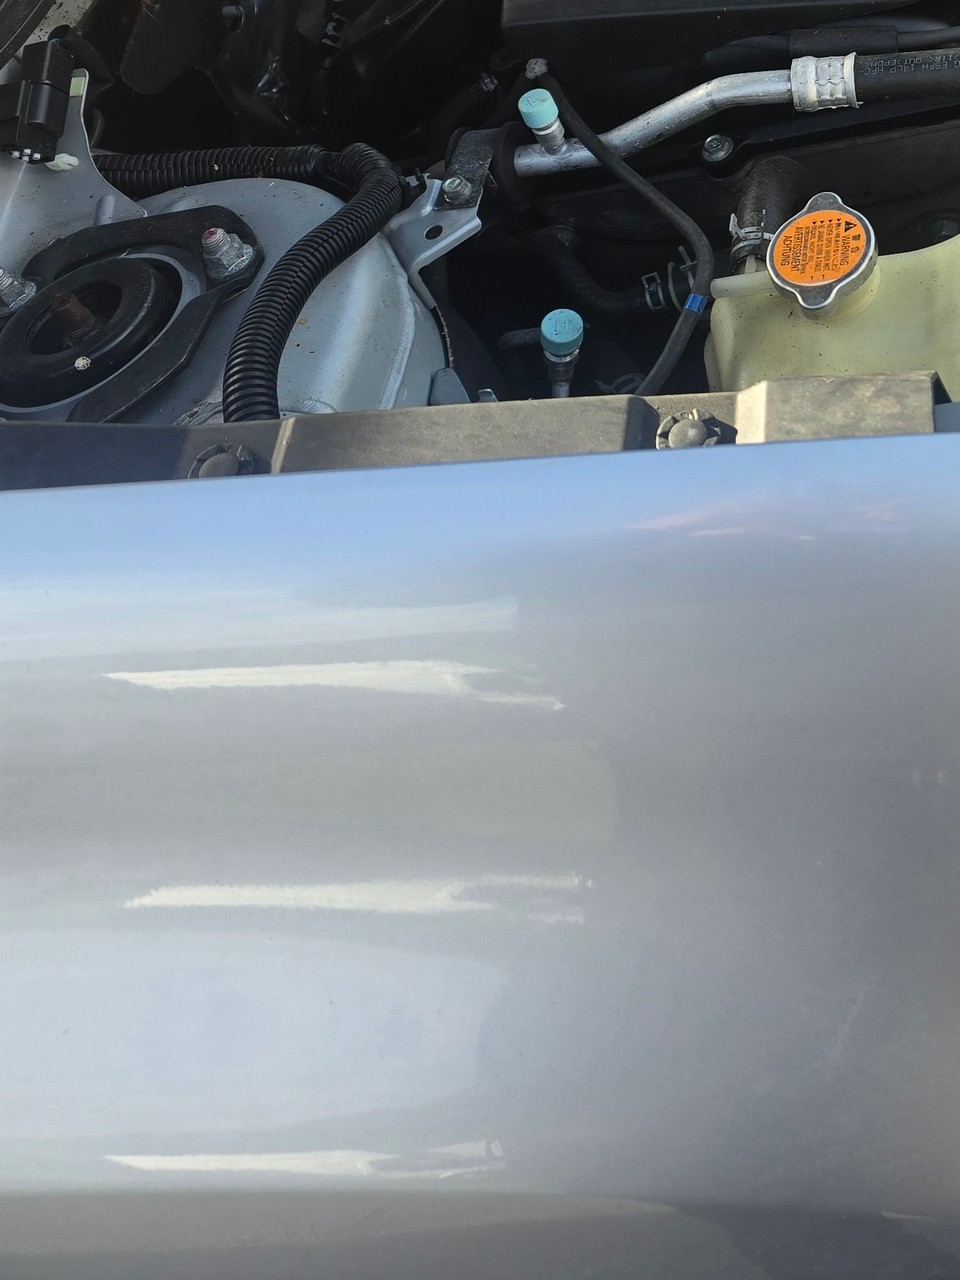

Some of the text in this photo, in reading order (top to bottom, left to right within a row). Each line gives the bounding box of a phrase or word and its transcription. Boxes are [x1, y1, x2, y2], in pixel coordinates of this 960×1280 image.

[921, 62, 948, 70] ESFH
[780, 236, 792, 266] ACHTUNG
[791, 227, 803, 272] AVERTISSEMENT
[839, 234, 851, 266] WARNING
